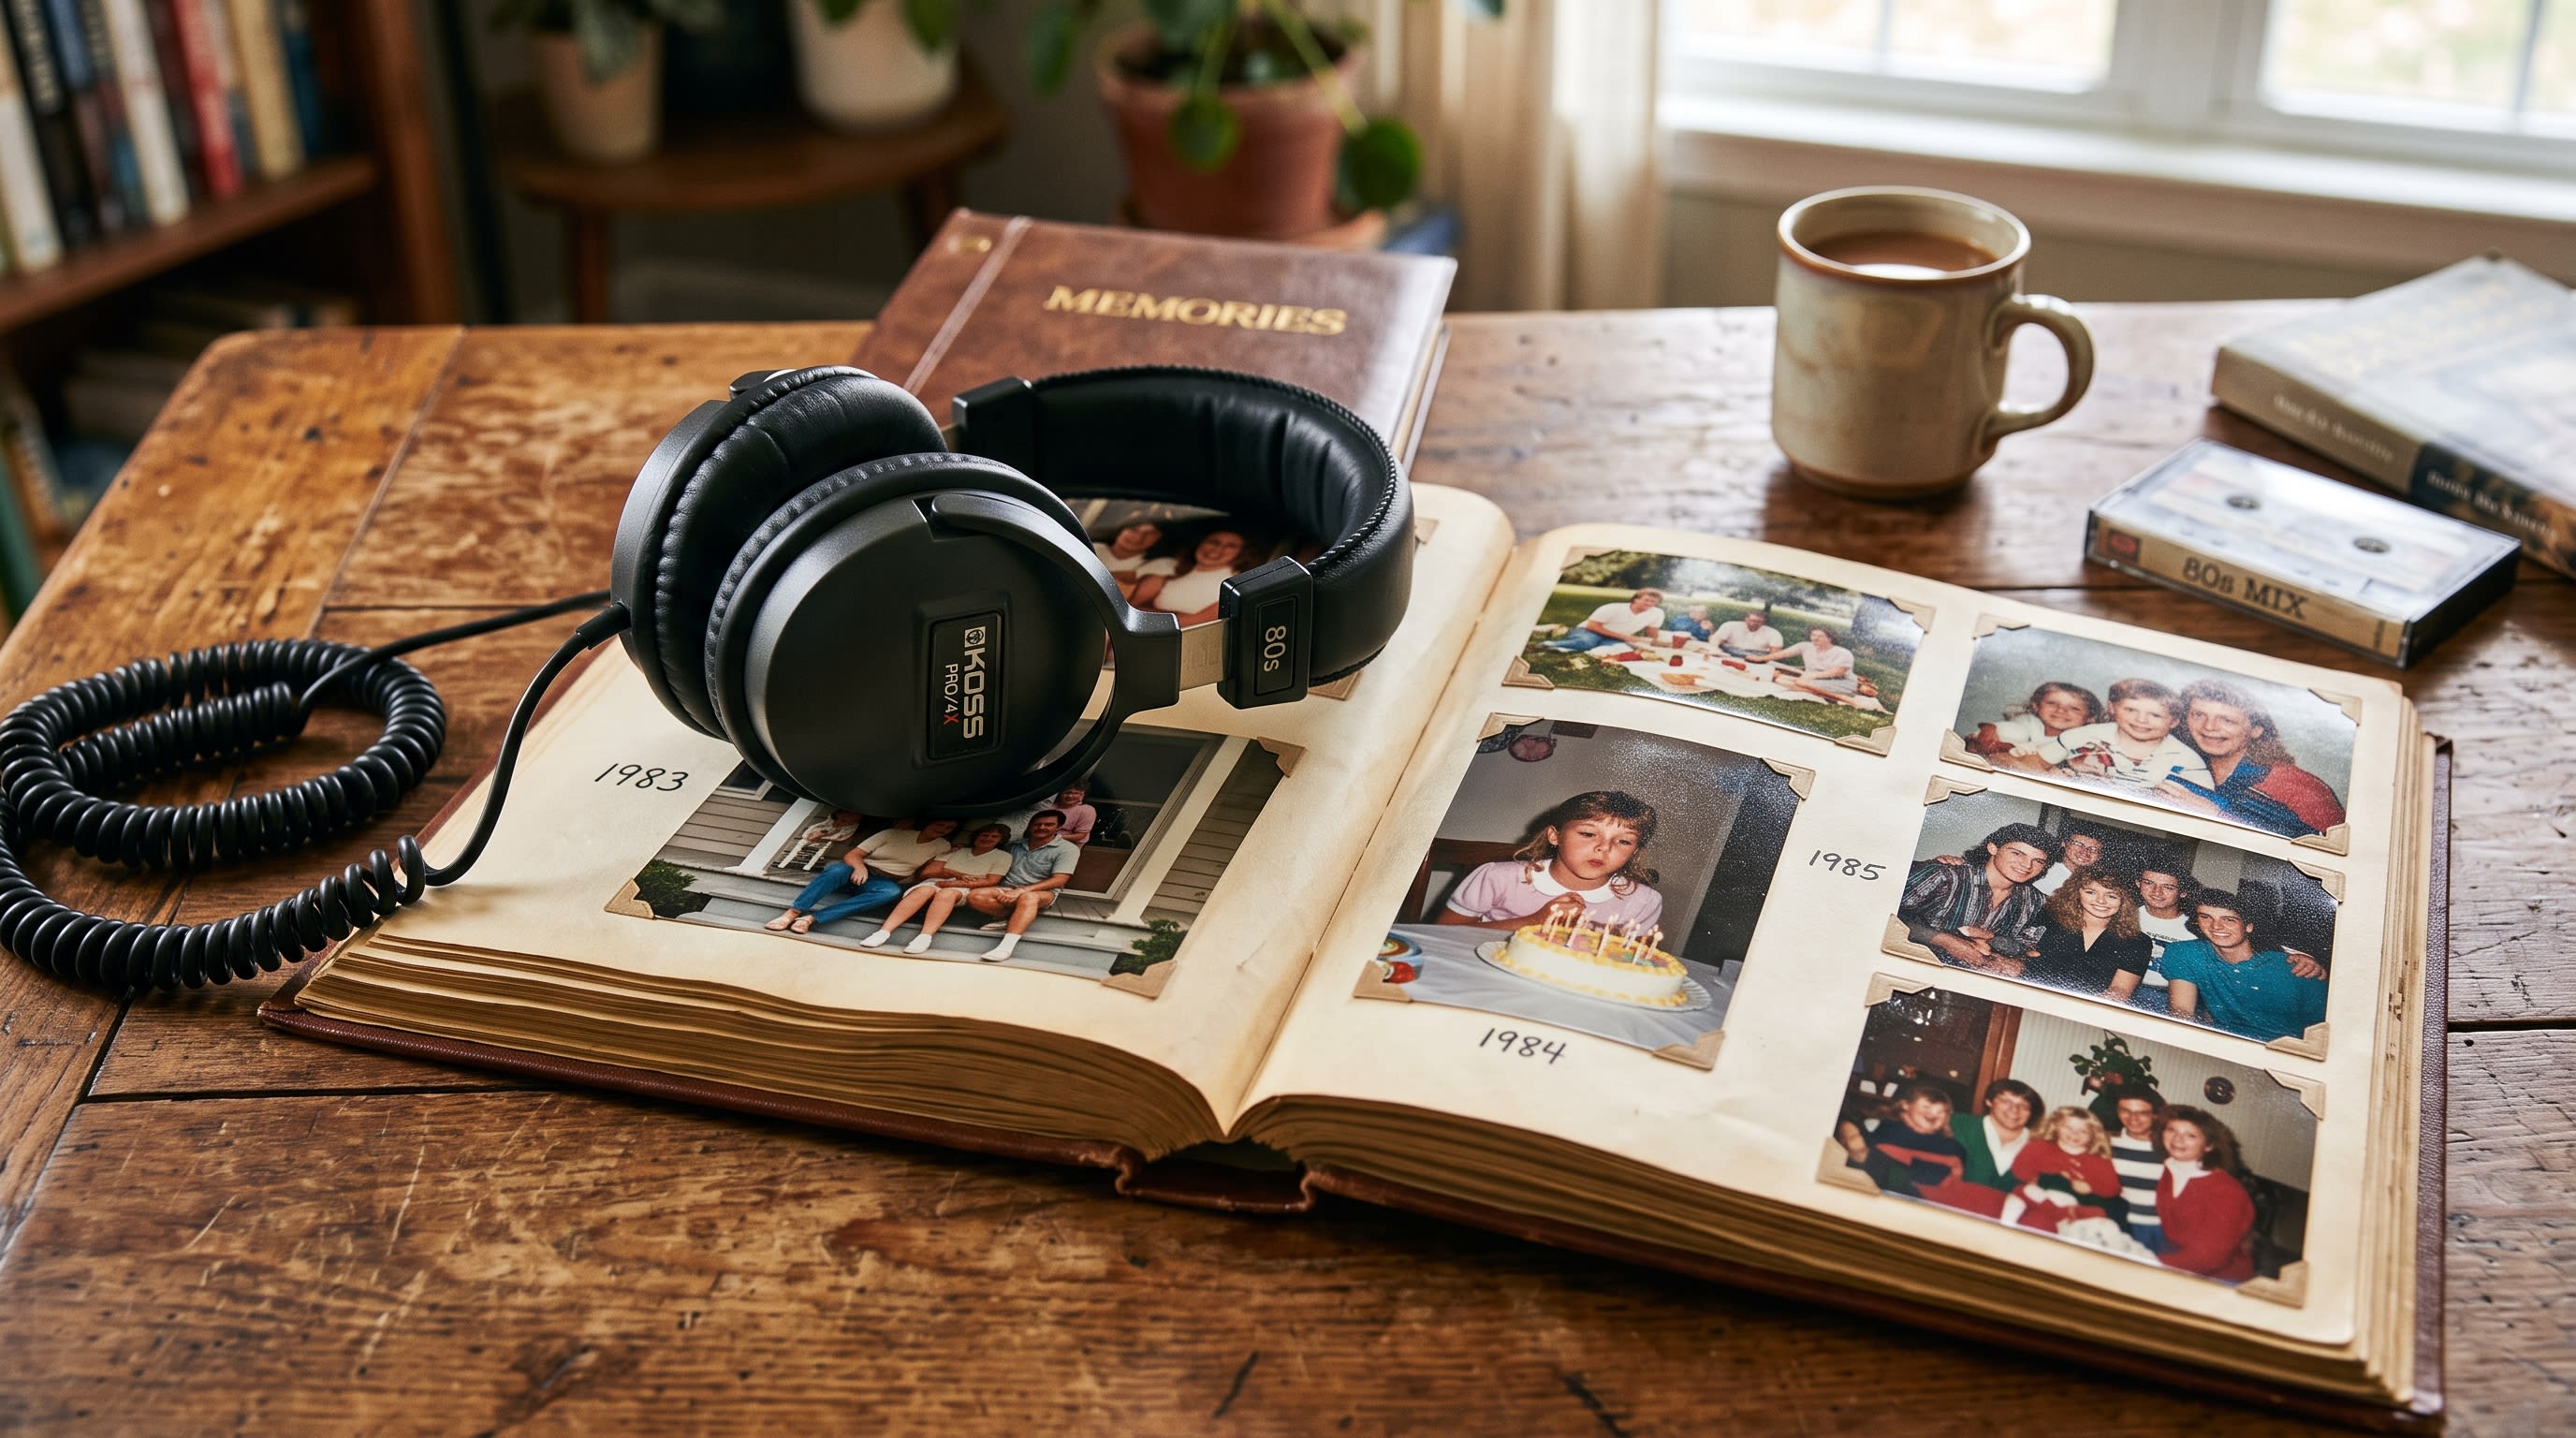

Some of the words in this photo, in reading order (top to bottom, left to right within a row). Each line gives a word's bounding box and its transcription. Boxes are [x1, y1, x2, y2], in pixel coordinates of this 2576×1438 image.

[1043, 285, 1347, 336] MEMORIES
[2182, 556, 2234, 594] 80s
[2243, 577, 2309, 619] MIX
[1263, 625, 1287, 672] 80s
[944, 663, 959, 726] PRO/4X
[963, 647, 986, 739] KOSS
[594, 763, 689, 791] 1983
[1808, 849, 1887, 881] 1985
[1479, 1028, 1566, 1064] 1984
